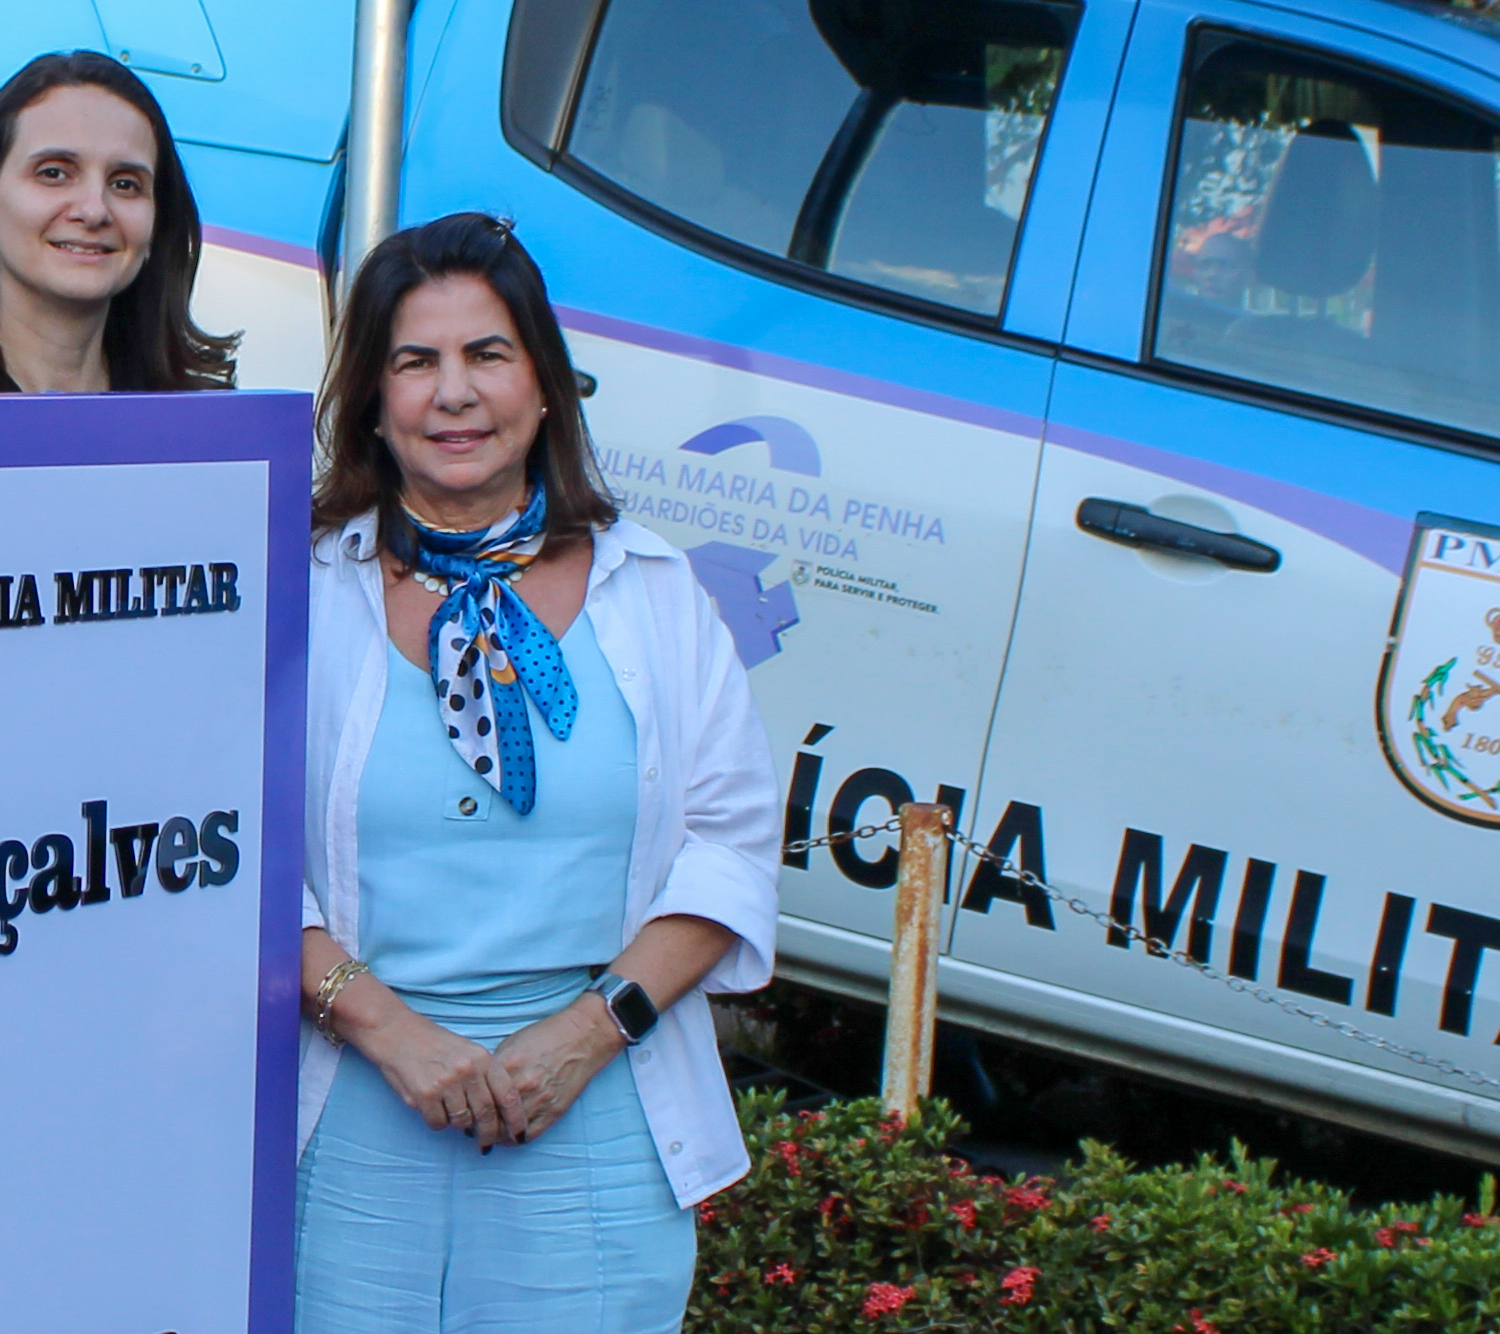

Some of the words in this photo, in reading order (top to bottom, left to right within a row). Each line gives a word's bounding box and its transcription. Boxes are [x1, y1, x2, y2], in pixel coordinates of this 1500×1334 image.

[597, 446, 667, 486] ULHA
[677, 463, 777, 508] MARIA
[788, 486, 832, 521] DA
[843, 498, 946, 545] PENHA
[752, 517, 788, 546] DA
[799, 527, 859, 561] VIDA
[53, 561, 241, 626] MILITAR
[814, 578, 839, 591] PARA
[782, 724, 1057, 931] ÍCIA
